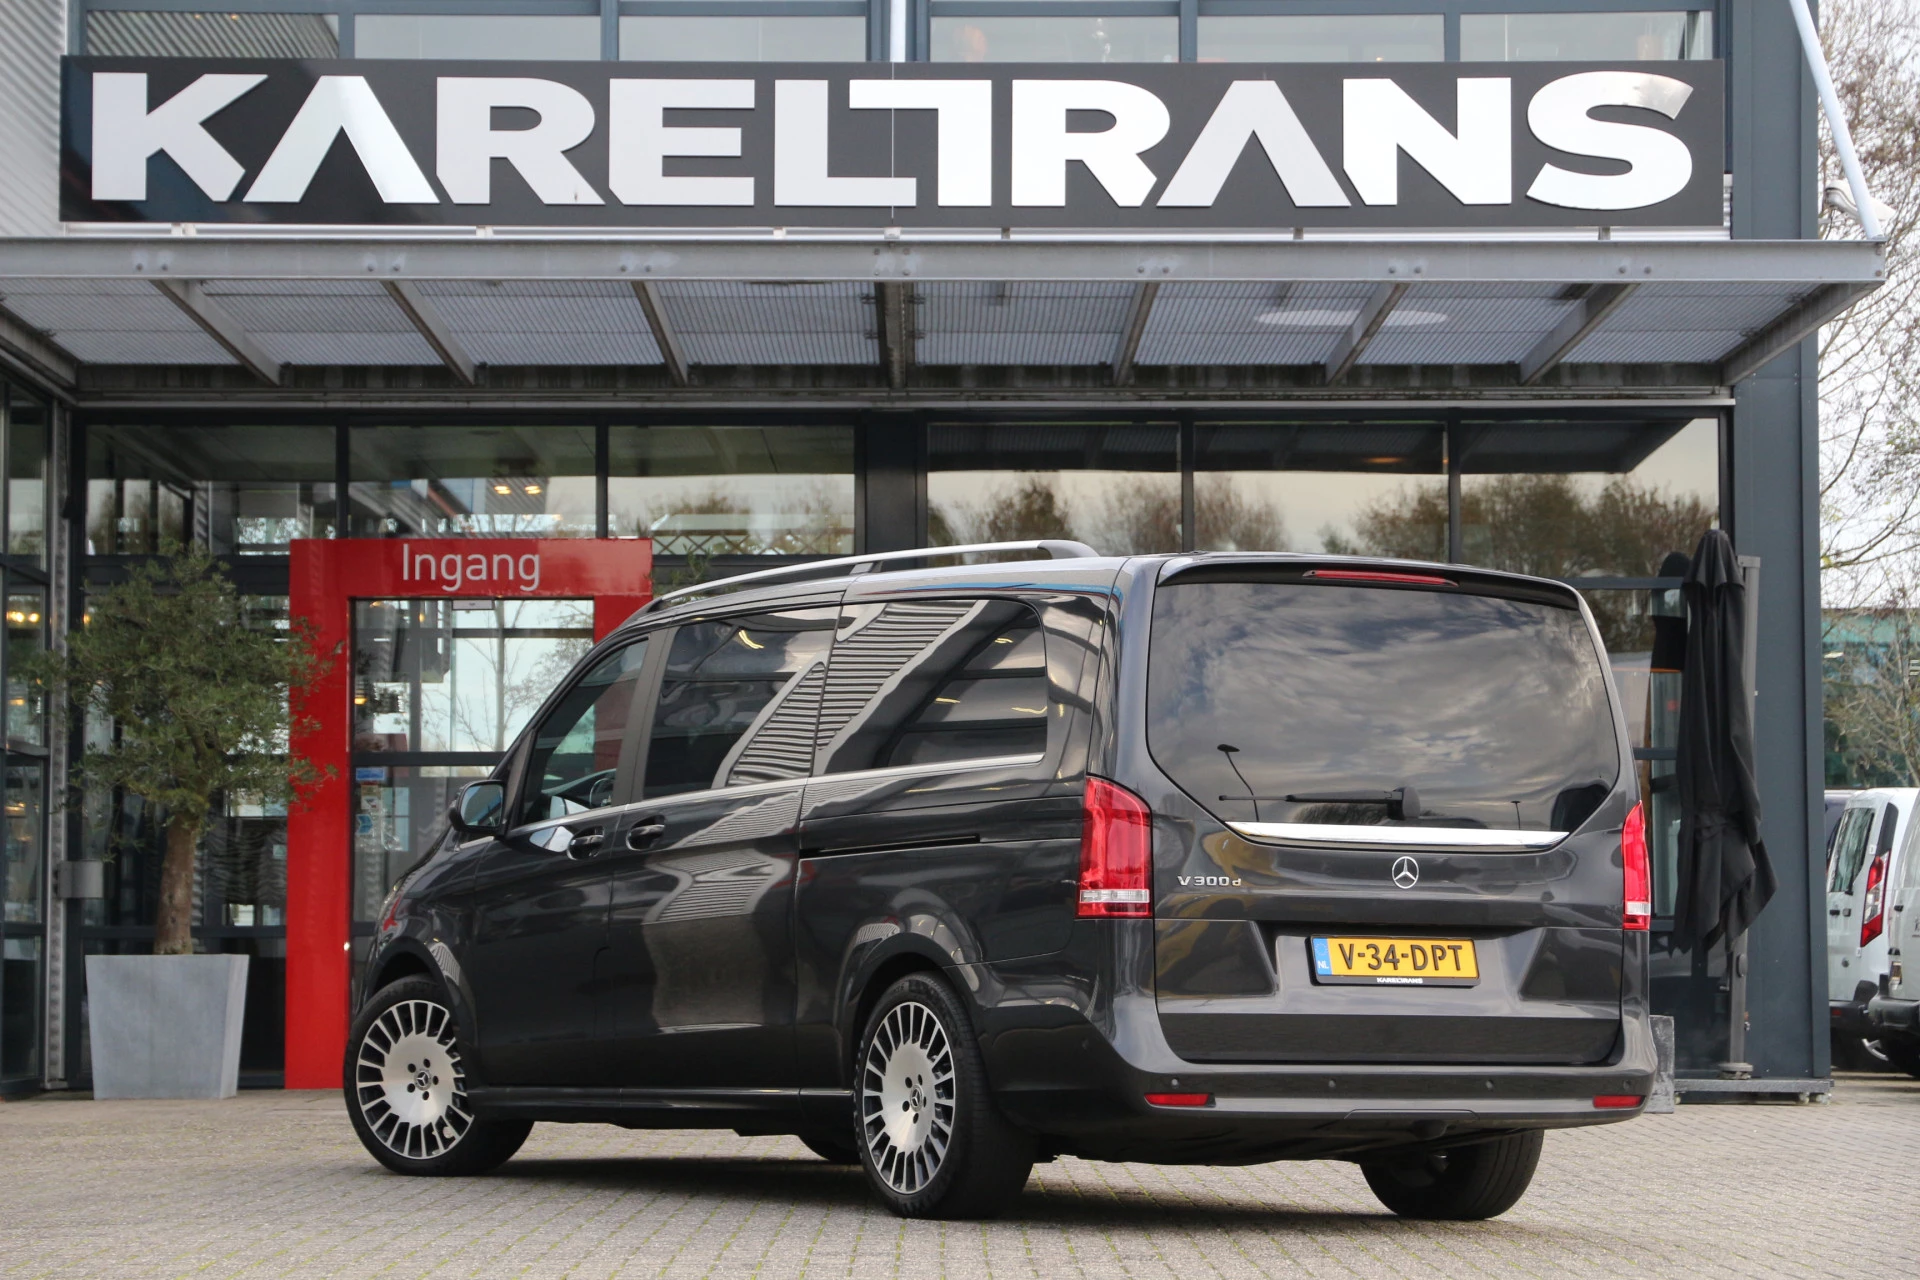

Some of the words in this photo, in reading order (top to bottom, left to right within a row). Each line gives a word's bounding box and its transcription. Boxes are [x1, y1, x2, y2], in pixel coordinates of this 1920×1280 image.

[91, 70, 1694, 210] KARELTRANS
[402, 543, 541, 592] Ingang
[1317, 960, 1330, 970] NL
[1339, 942, 1463, 971] V-34-DPT
